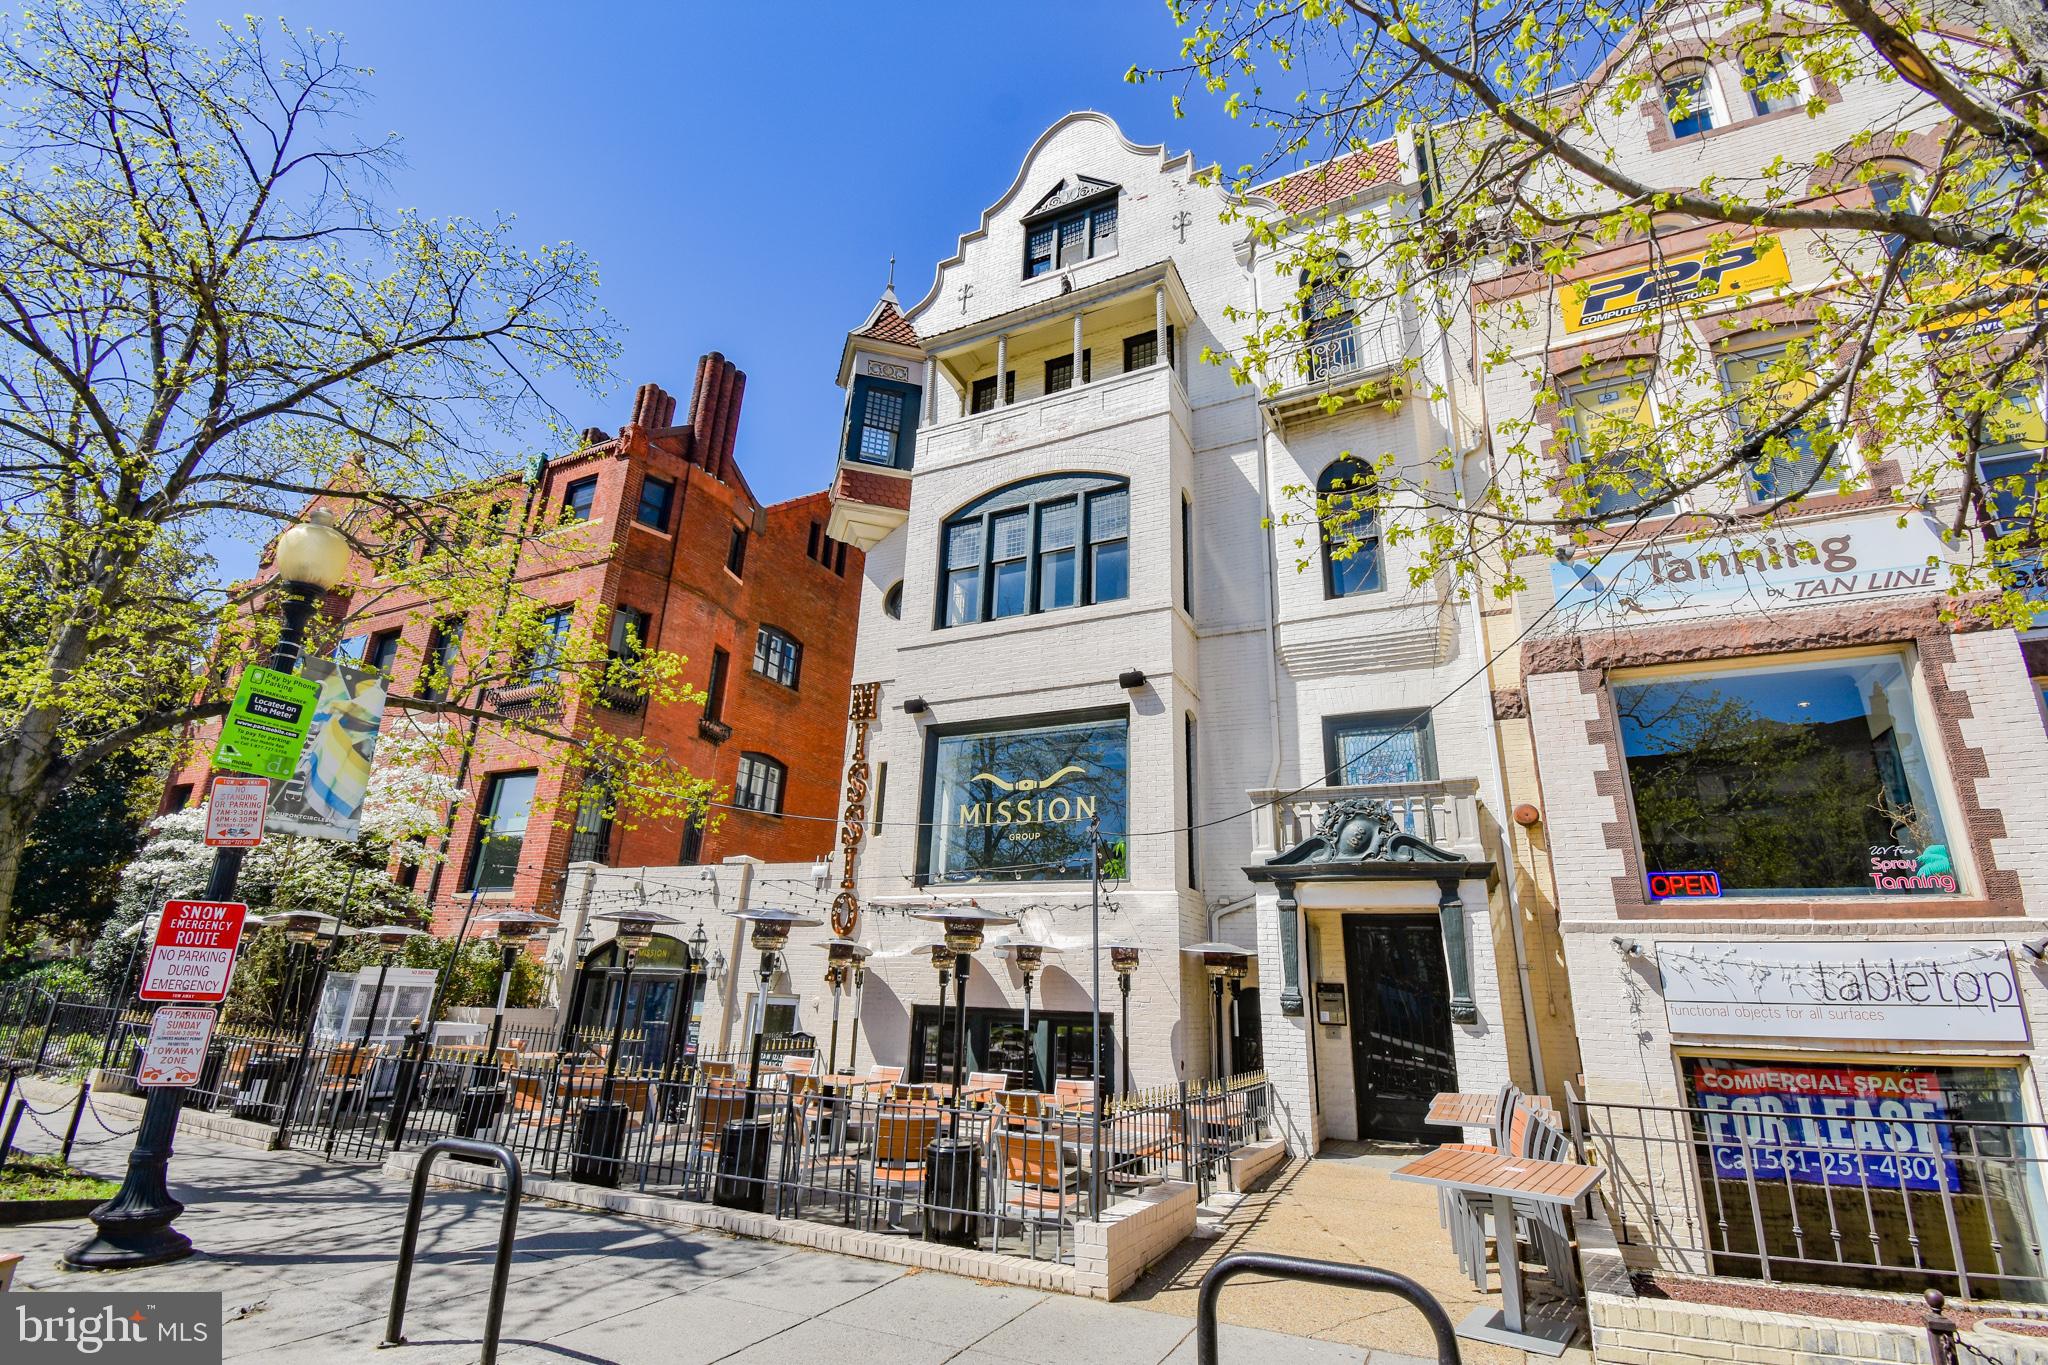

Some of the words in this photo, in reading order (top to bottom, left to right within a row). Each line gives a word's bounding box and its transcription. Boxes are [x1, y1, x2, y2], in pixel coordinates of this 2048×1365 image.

[1582, 246, 1761, 316] P2P
[1581, 304, 1646, 325] COMPUTER
[1636, 535, 1857, 585] Tanning
[1766, 587, 1785, 597] by
[1795, 575, 1858, 598] TAN
[1868, 566, 1937, 590] LINE
[265, 680, 293, 692] Parking
[267, 673, 278, 682] Pay
[283, 676, 292, 685] by
[294, 680, 316, 690] Phone
[254, 697, 285, 710] Located
[254, 705, 268, 713] the
[270, 708, 293, 719] Meter
[236, 720, 298, 738] www.parkmobile.com
[959, 795, 1096, 828] MISSION
[1009, 832, 1041, 841] GROUP
[1871, 857, 1917, 872] Spray
[1651, 875, 1718, 896] OPEN
[1869, 873, 1956, 893] Tanning
[180, 905, 227, 920] SNOW
[170, 919, 233, 930] EMERGENCY
[176, 931, 221, 945] ROUTE
[158, 949, 176, 960] NO
[178, 950, 227, 963] PARKING
[168, 965, 210, 976] DURING
[151, 979, 220, 991] EMERGENCY
[1815, 958, 2013, 1012] tabletop
[175, 1011, 212, 1020] PARKING
[1670, 1004, 1730, 1017] functional
[1735, 1005, 1781, 1020] objects
[1786, 1006, 1804, 1019] for
[1809, 1007, 1823, 1019] all
[1828, 1006, 1885, 1021] surfaces
[167, 1021, 202, 1029] SUNDAY
[1703, 1072, 1848, 1092] COMMERCIAL
[1853, 1075, 1930, 1095] SPACE
[1705, 1094, 1792, 1146] FOR
[1800, 1097, 1944, 1154] LEASE
[1716, 1147, 1759, 1170] Cal
